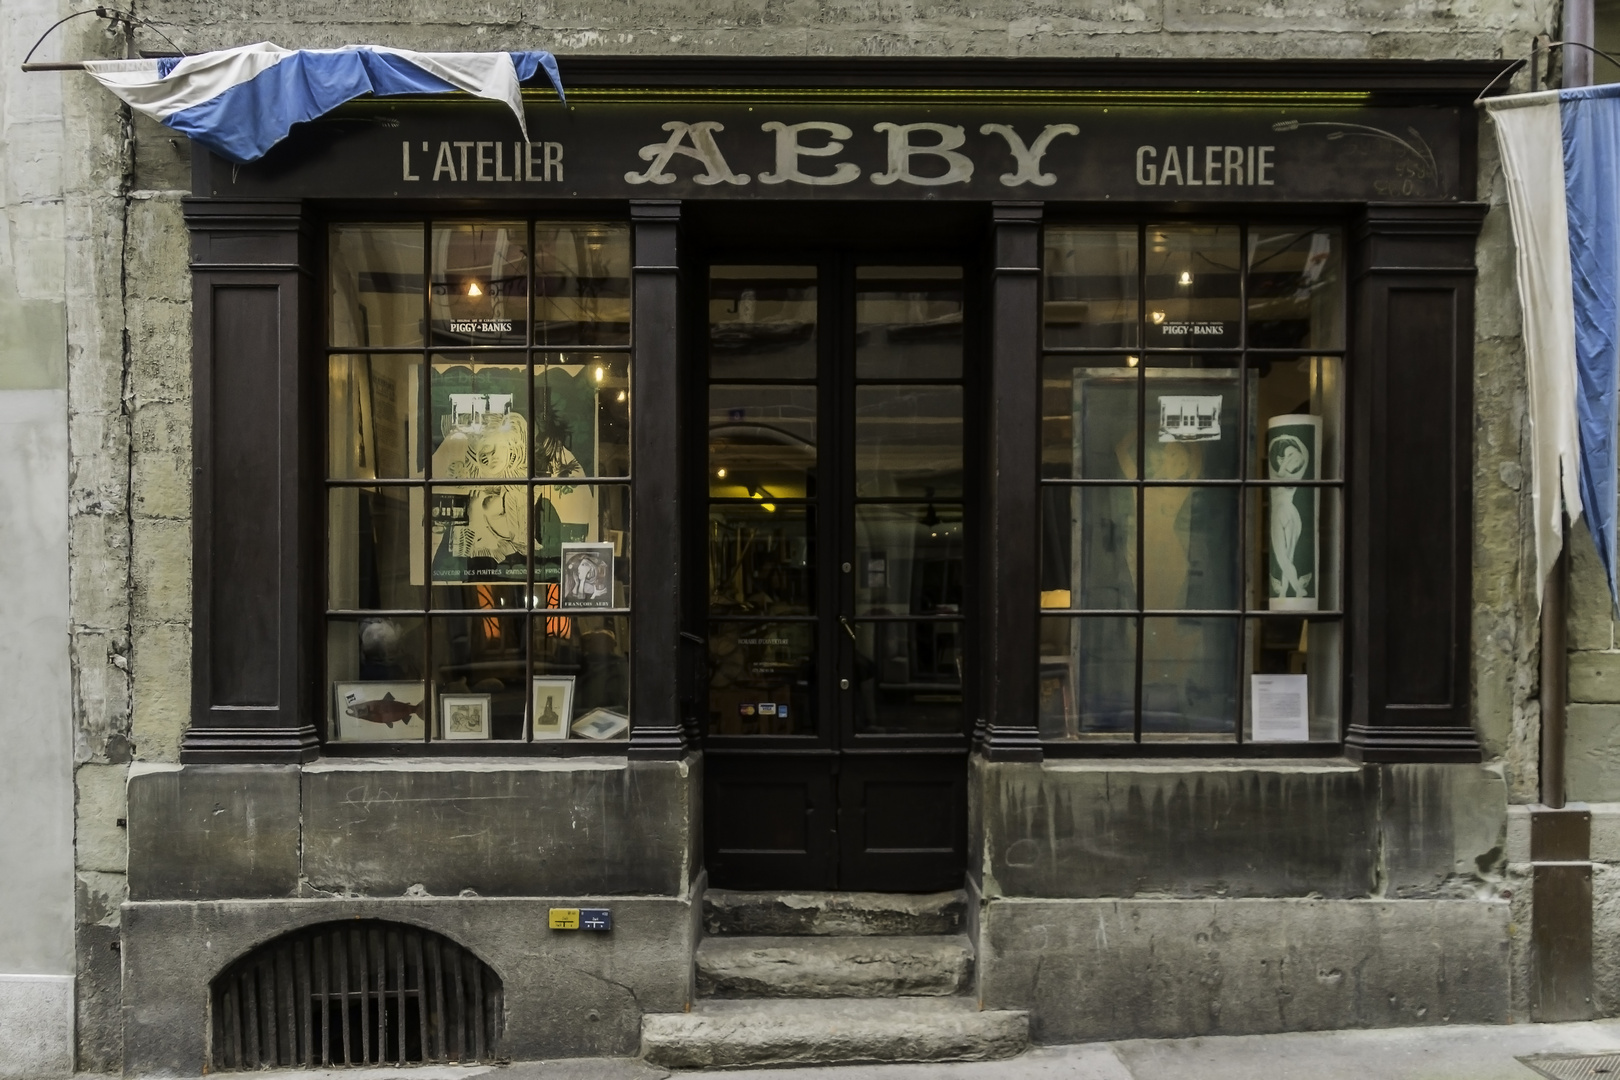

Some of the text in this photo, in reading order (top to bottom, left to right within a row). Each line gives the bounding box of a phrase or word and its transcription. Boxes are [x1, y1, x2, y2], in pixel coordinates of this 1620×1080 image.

[402, 141, 564, 182] L'ATELIER
[624, 121, 1080, 186] AEBY
[1136, 145, 1275, 186] GALERIE
[450, 323, 512, 332] PIGGY BANKS
[1162, 325, 1224, 335] PIGGY BANKS
